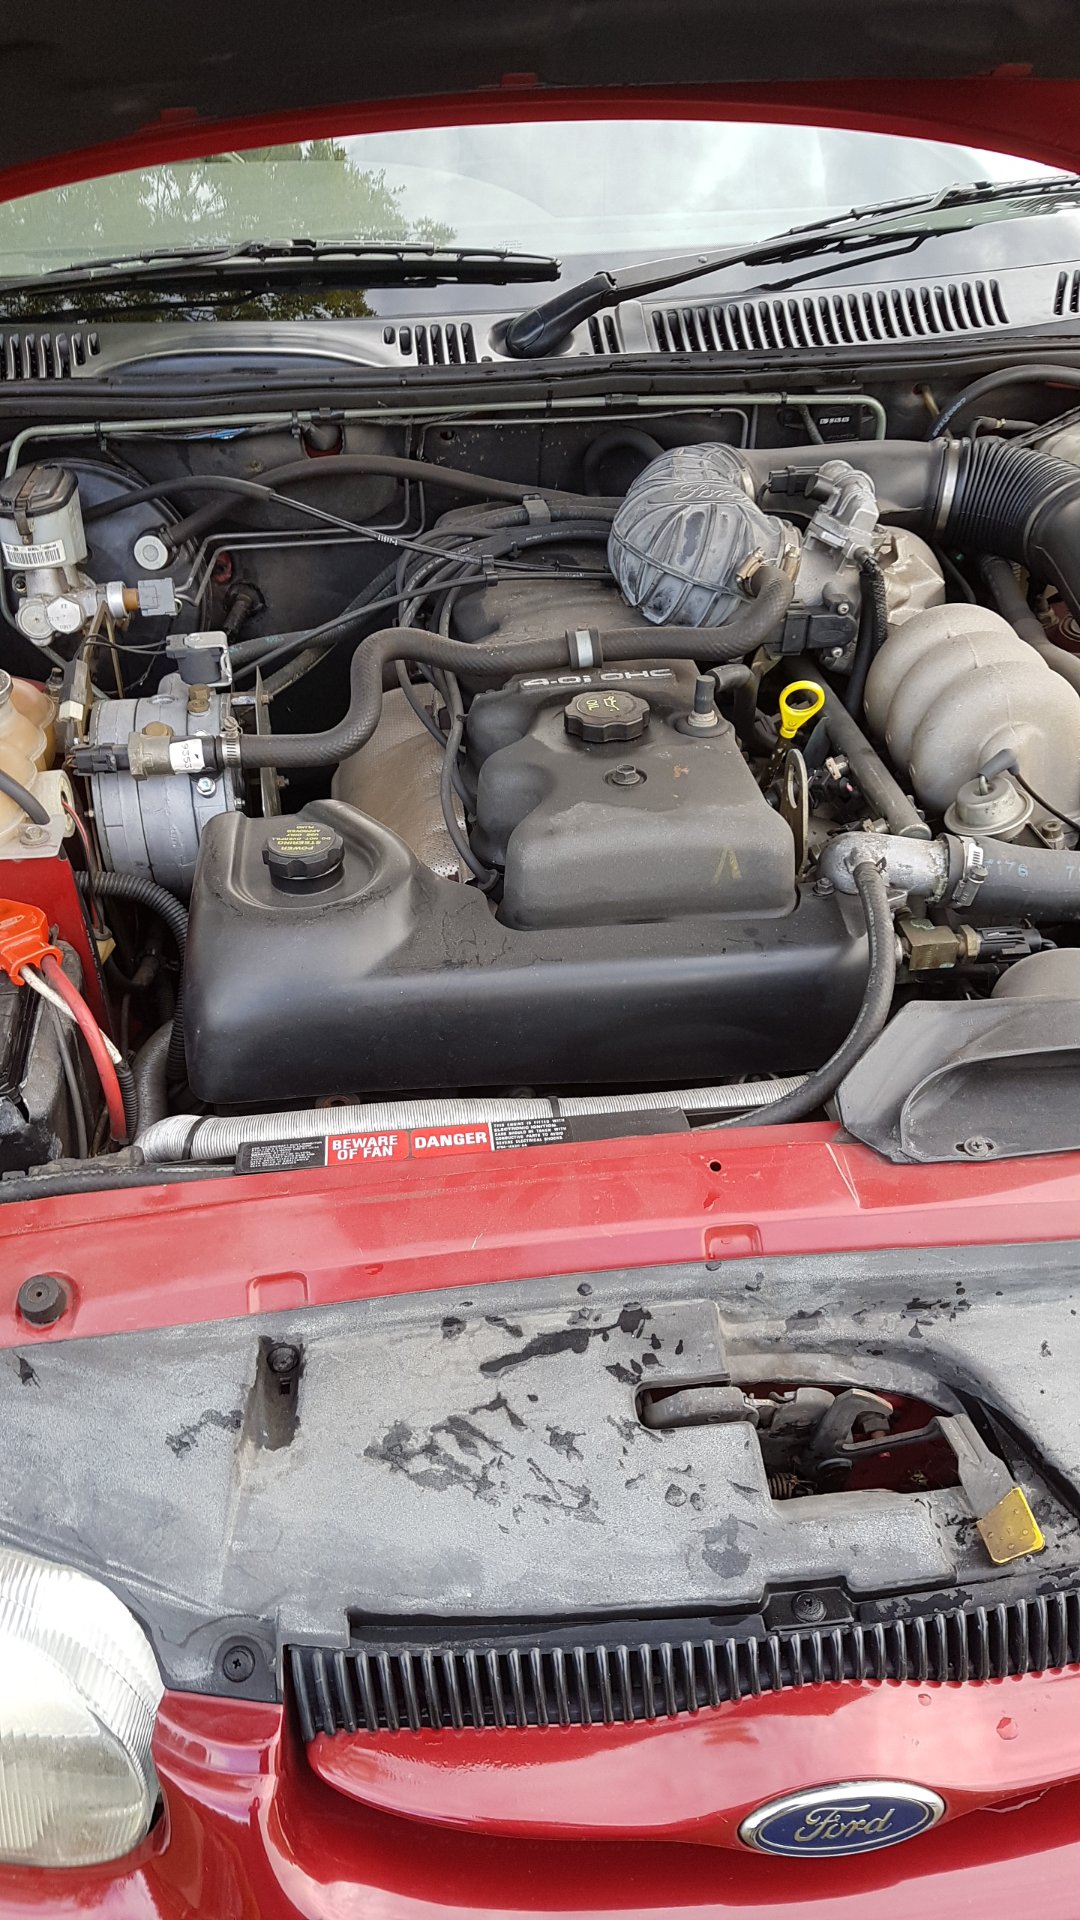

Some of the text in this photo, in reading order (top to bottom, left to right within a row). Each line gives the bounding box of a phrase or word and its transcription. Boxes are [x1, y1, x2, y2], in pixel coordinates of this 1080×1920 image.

[600, 668, 673, 681] OHC
[586, 699, 600, 711] OIL
[332, 1134, 398, 1151] BEWARE
[414, 1131, 488, 1149] DANGER
[337, 1149, 358, 1161] OF
[363, 1145, 393, 1159] FAN
[794, 1803, 896, 1842] Ford
